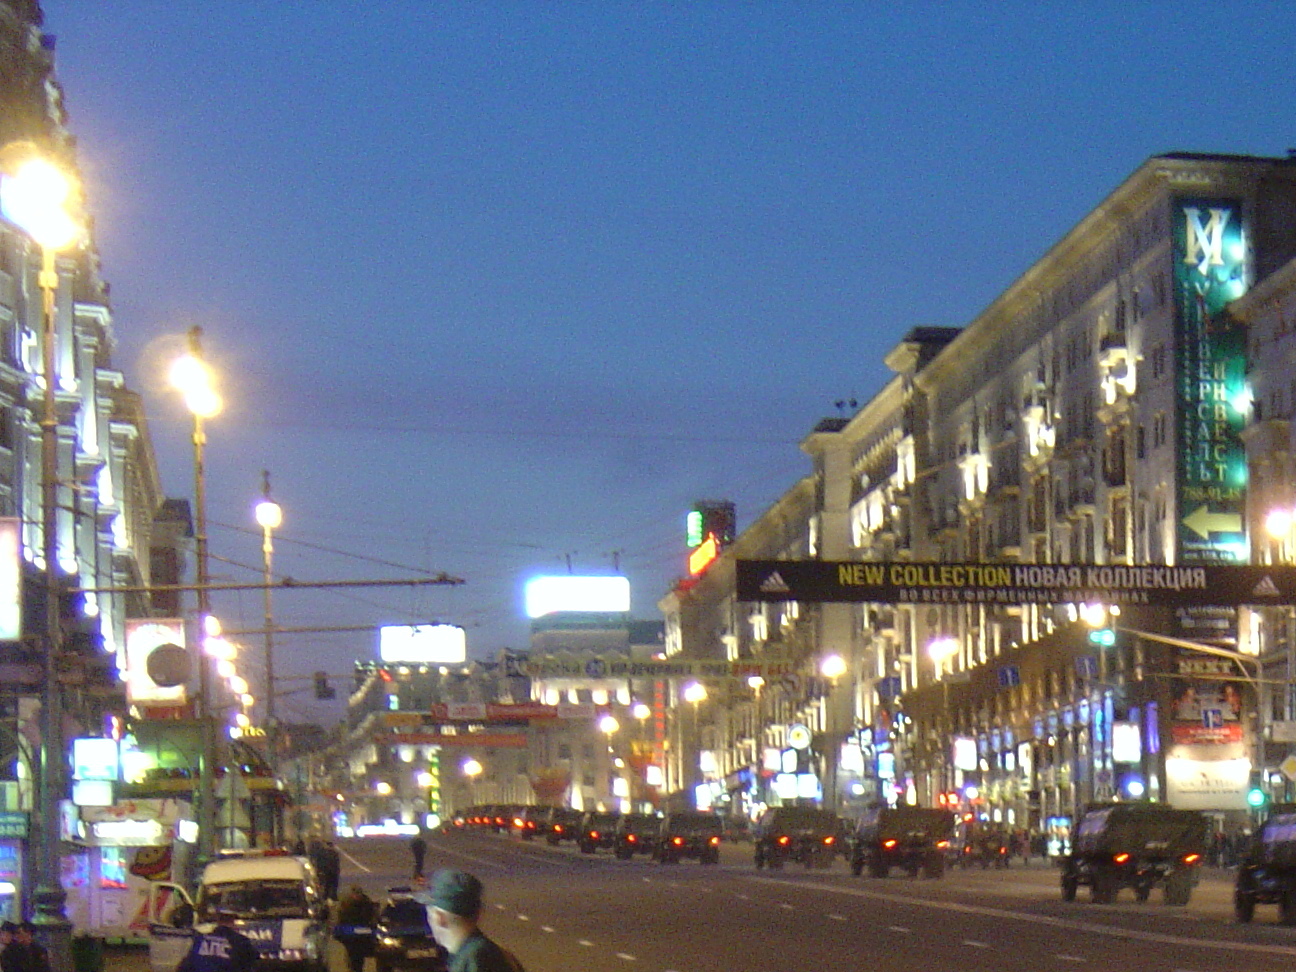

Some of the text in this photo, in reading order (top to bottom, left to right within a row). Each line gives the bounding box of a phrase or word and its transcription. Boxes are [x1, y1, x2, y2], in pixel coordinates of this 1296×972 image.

[838, 564, 1206, 591] NEW COLLECTION НОВАЯ КОЛЛЕКЦИЯ
[899, 588, 917, 600] ВО
